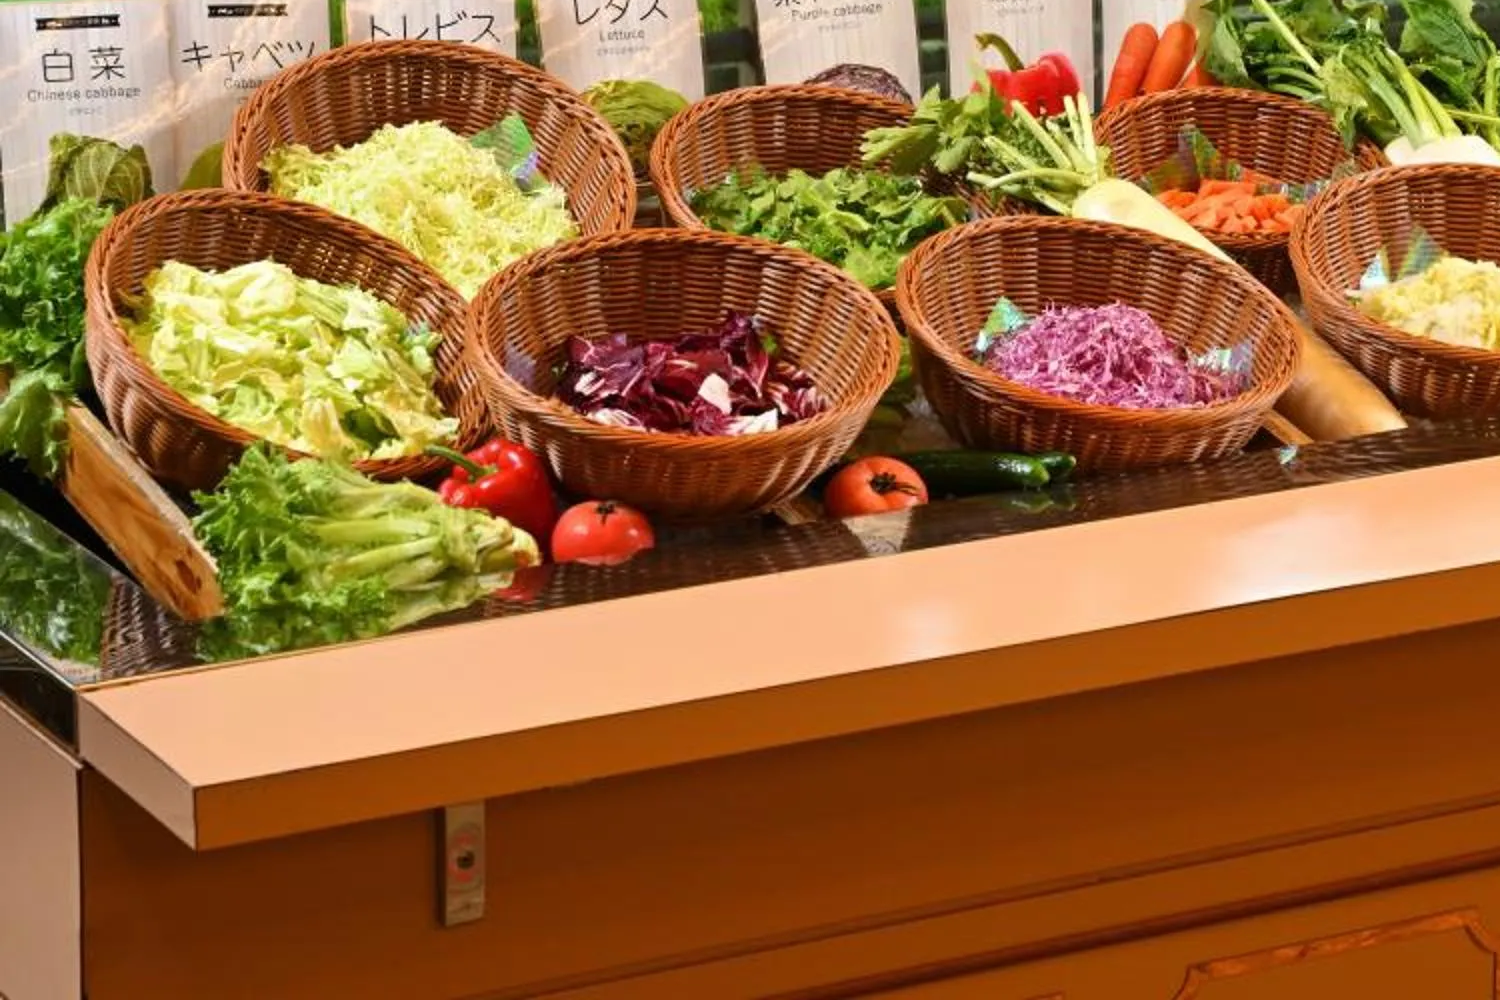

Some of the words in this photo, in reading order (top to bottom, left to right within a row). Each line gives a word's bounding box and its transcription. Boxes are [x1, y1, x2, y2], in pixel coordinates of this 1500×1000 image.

[369, 10, 501, 43] トレビス
[41, 47, 126, 83] 白菜
[181, 40, 316, 74] キャベツ
[27, 88, 80, 102] Chinese
[85, 85, 141, 99] cabbage
